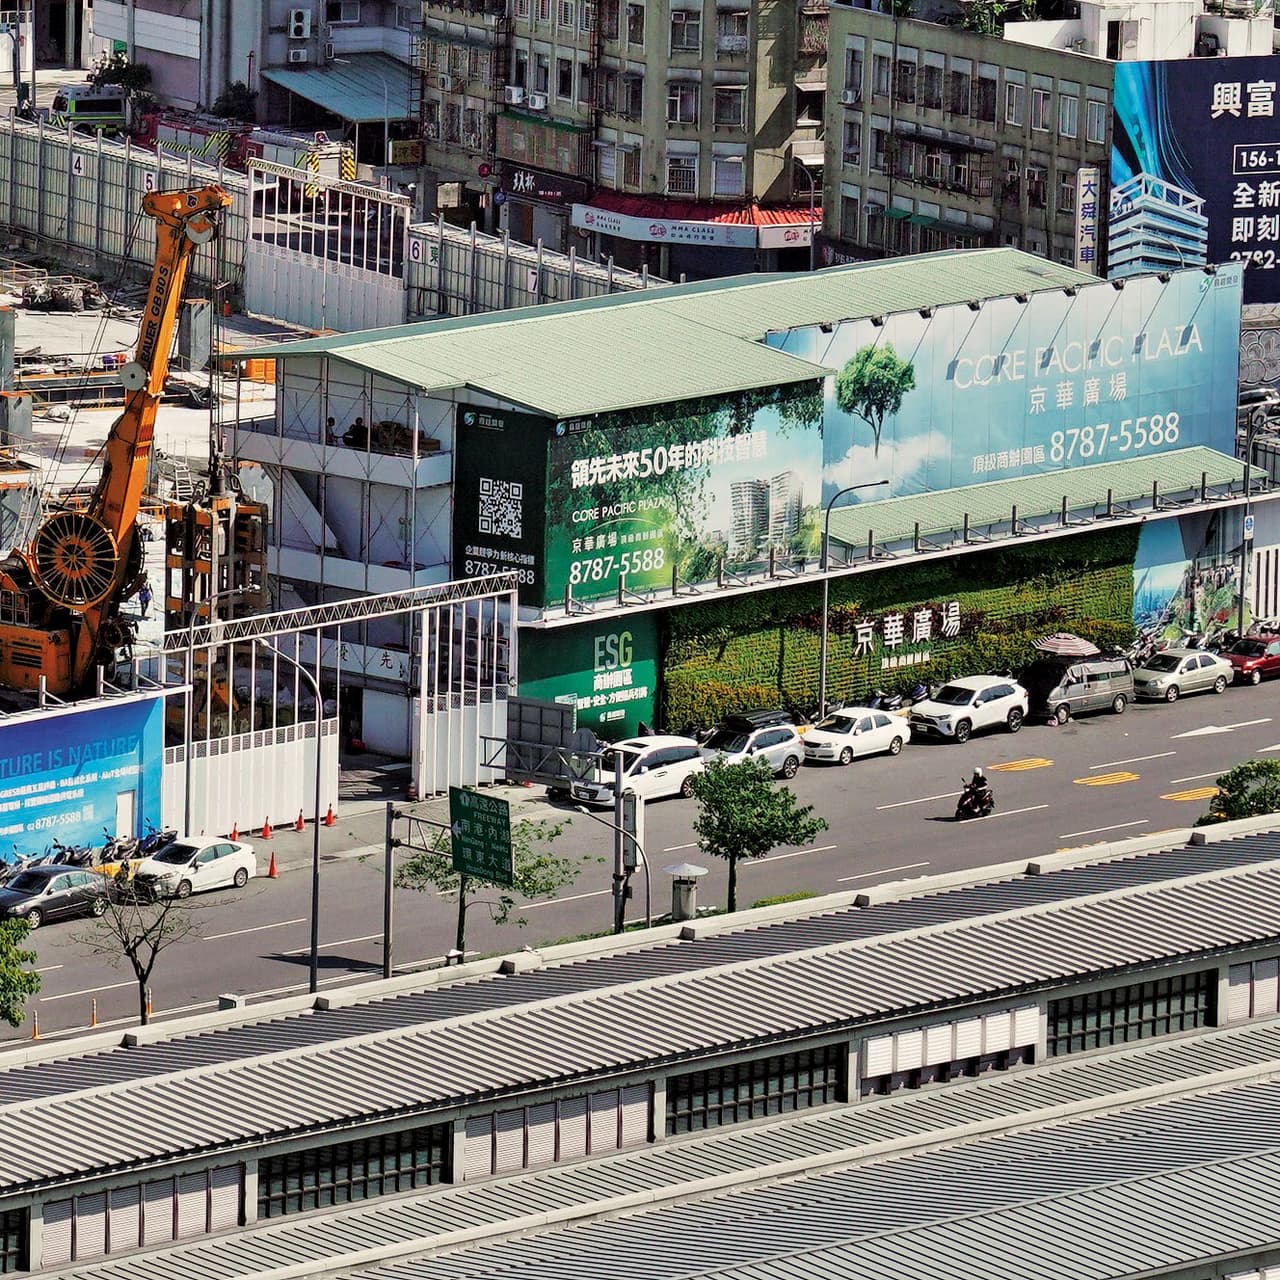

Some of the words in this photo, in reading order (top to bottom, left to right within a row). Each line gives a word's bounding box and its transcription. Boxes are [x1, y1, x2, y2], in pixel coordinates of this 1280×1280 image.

[1211, 80, 1277, 119] 興富
[74, 157, 83, 173] 4
[146, 173, 154, 191] 5
[1080, 180, 1098, 264] 大舜汽車
[411, 239, 420, 260] 6
[531, 271, 539, 293] 7
[141, 320, 158, 362] BAUER
[151, 295, 162, 317] GB
[954, 349, 1025, 390] CORE
[1035, 335, 1124, 378] PACIFIC
[1132, 323, 1203, 364] PLAZA
[1029, 372, 1128, 416] 京華廣場
[570, 430, 768, 489] 領先未來50年的科技智慧
[972, 445, 1045, 474] 頂級商辦園區
[1049, 411, 1180, 463] 8787-5588
[572, 507, 600, 523] CORE
[601, 500, 637, 518] PACIFIC
[638, 496, 666, 512] PLAZA
[572, 531, 618, 553] 京華廣場
[569, 548, 665, 585] 8787-5588
[854, 601, 961, 656] 京華廣場
[594, 631, 633, 672] ESG
[48, 748, 64, 769] IS
[68, 735, 137, 765] NATURE
[35, 810, 81, 830] 8787-5588
[473, 810, 506, 826] FREEWAY
